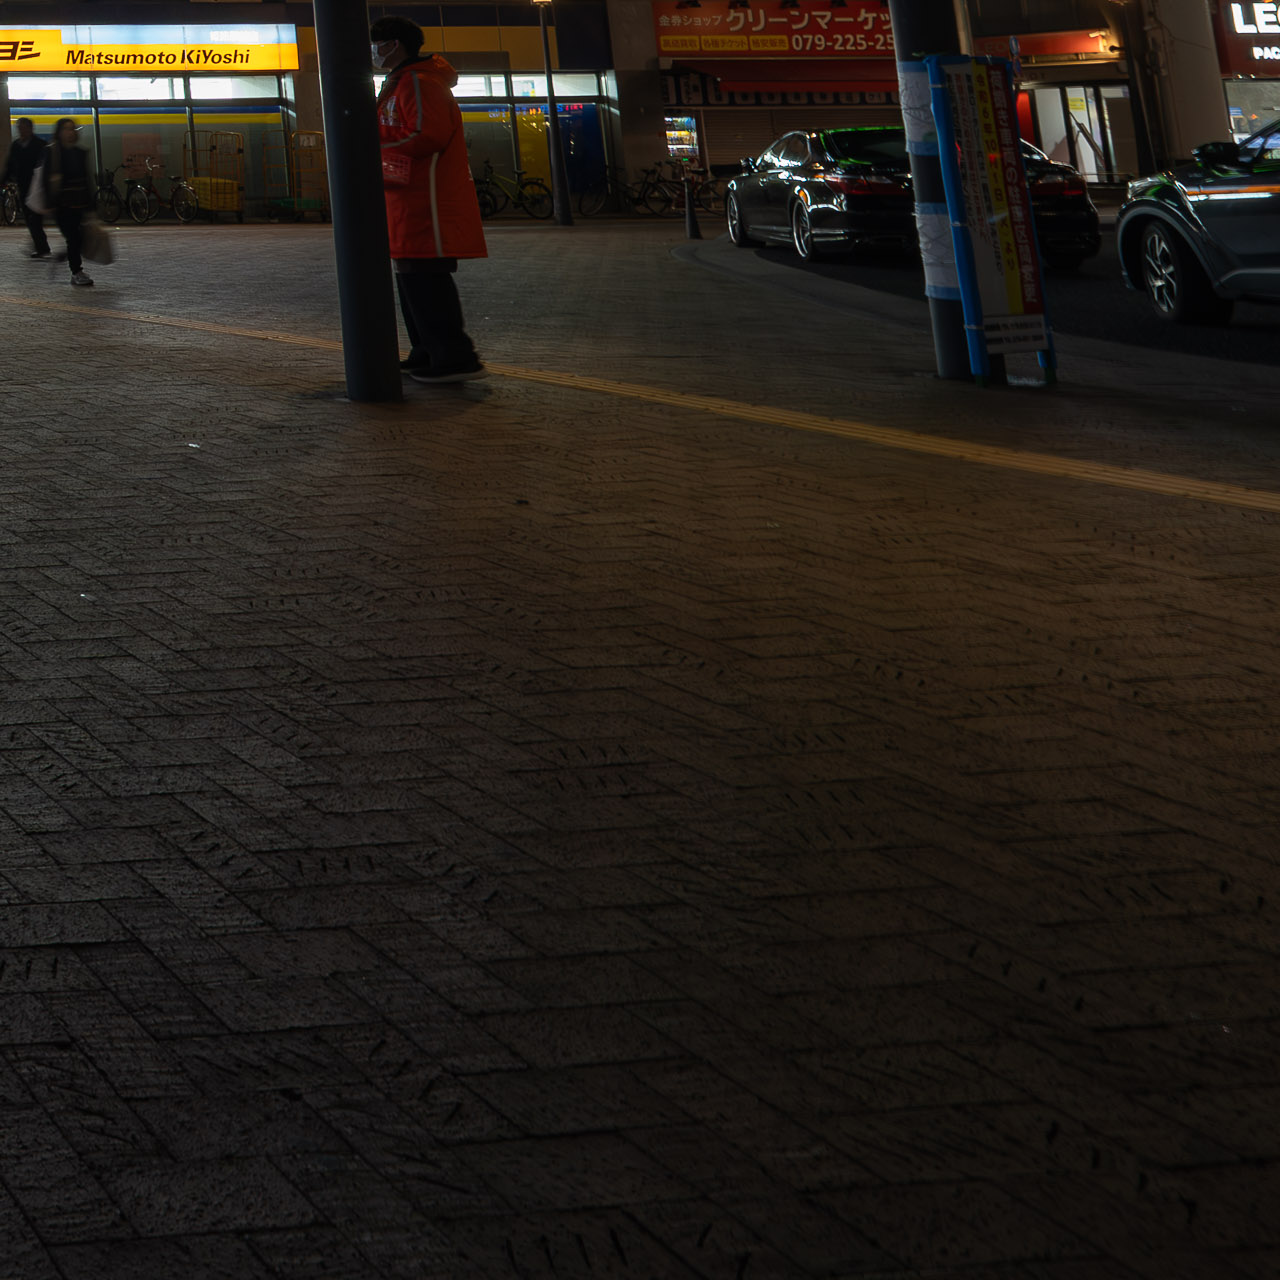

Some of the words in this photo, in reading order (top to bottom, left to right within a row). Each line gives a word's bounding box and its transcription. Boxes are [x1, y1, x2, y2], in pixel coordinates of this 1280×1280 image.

[658, 14, 722, 27] 金券ショップ
[1230, 2, 1280, 34] LE
[65, 48, 177, 66] Matsumoto
[181, 48, 251, 65] KiYoshi
